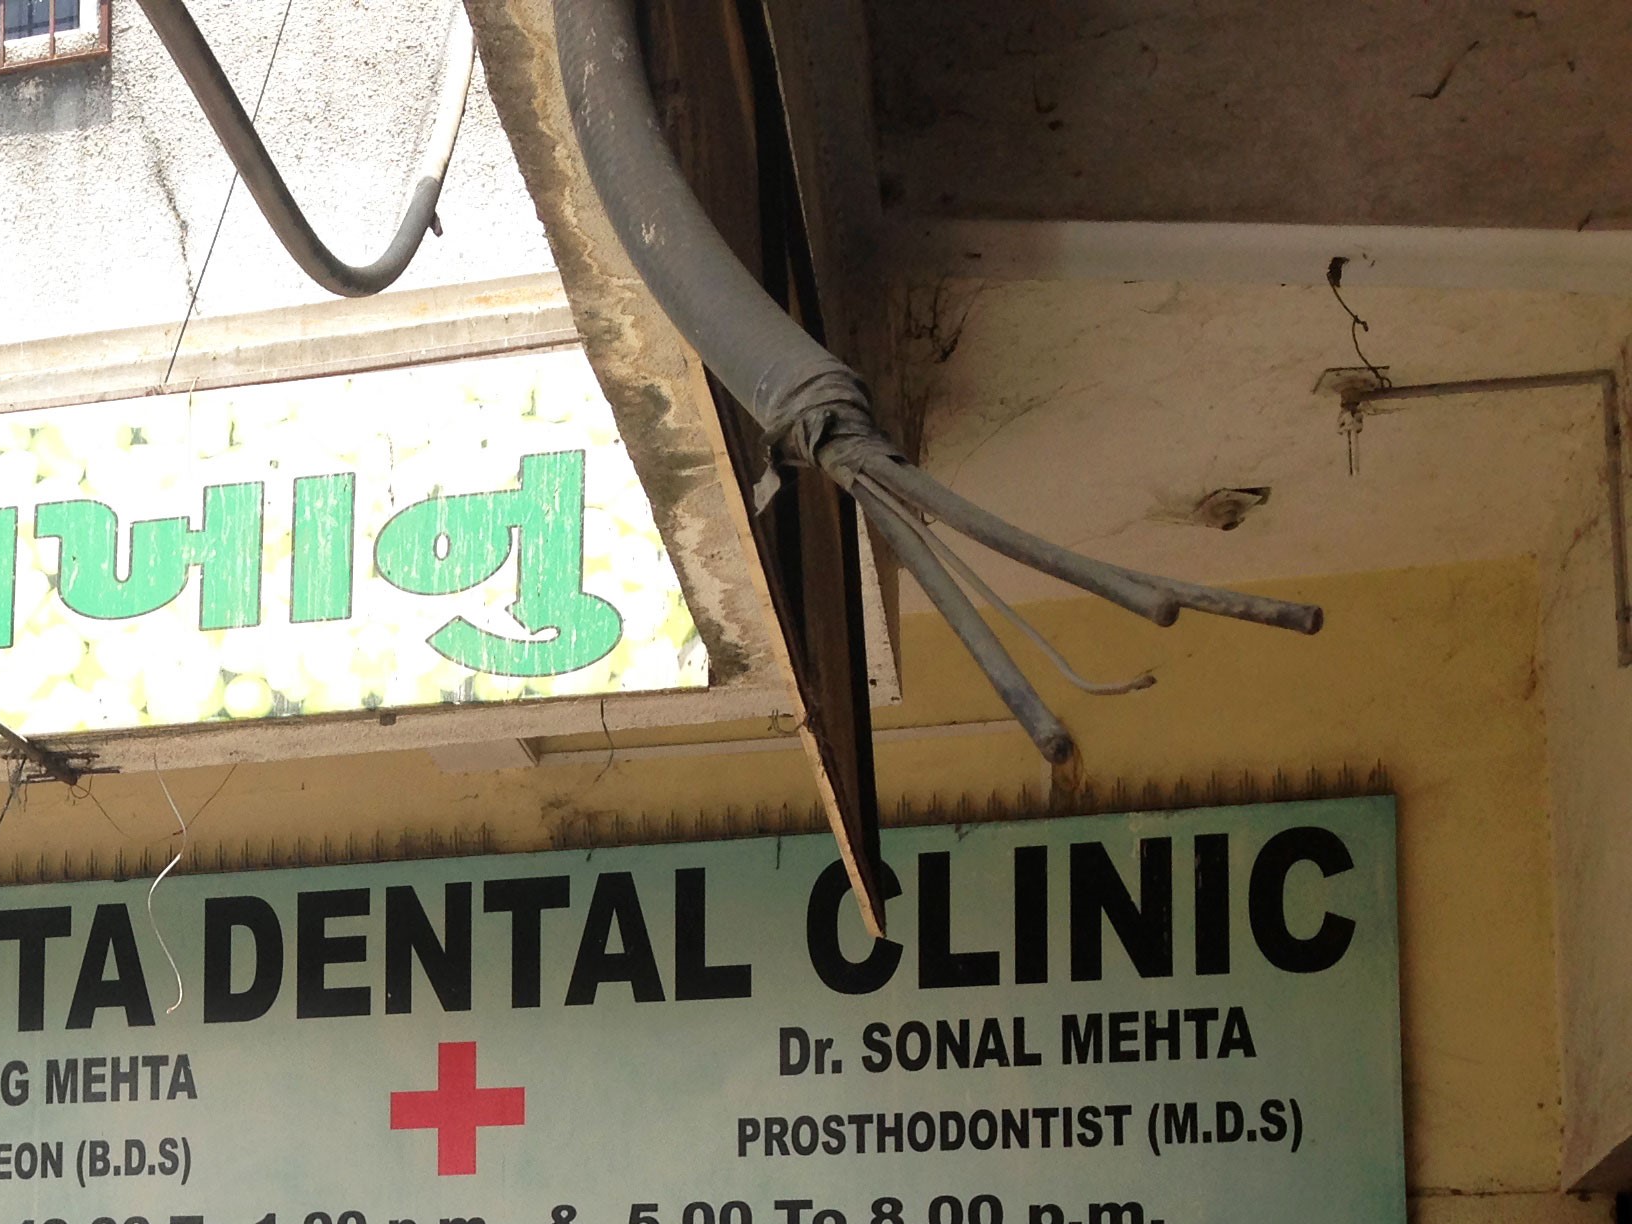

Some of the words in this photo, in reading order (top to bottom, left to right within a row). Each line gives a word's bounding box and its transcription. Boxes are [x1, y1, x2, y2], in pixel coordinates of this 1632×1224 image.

[203, 867, 752, 1025] DENTAL
[806, 826, 1357, 996] CLINIC
[778, 1026, 843, 1077] Dr.
[861, 1017, 1042, 1075] SONAL
[1062, 1006, 1257, 1065] MEHTA
[44, 1055, 198, 1106] MEHTA
[737, 1104, 1132, 1158] PROSTHODONTIST
[1147, 1098, 1303, 1155] (M.D.S)
[76, 1137, 193, 1190] (B.D.S)
